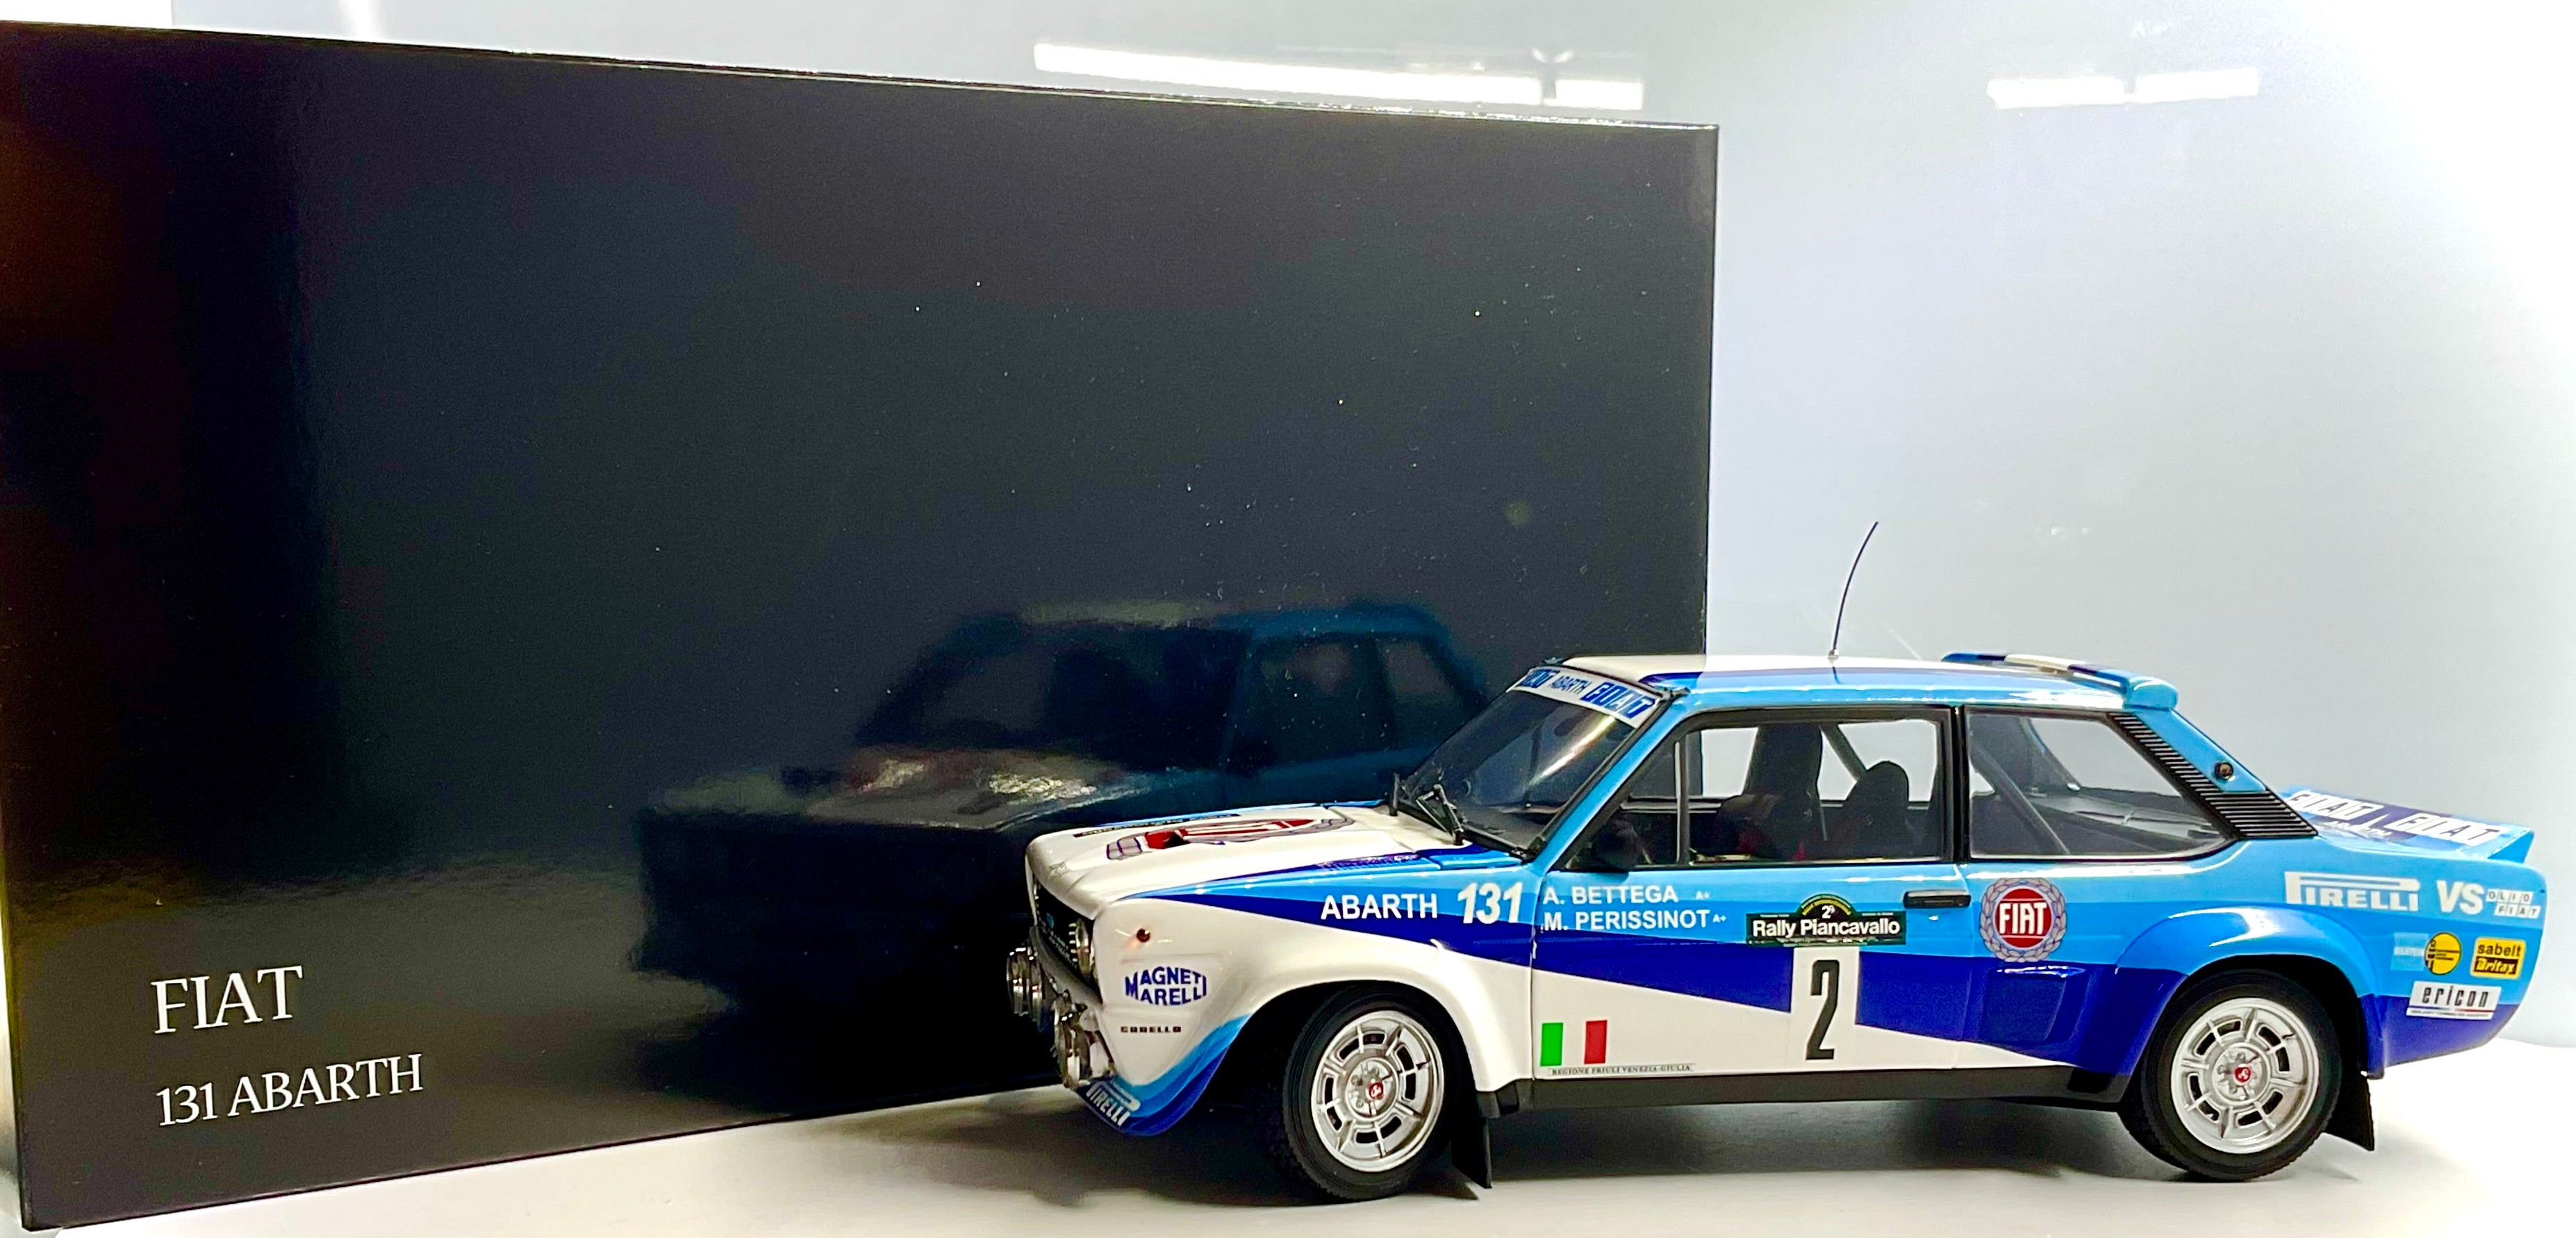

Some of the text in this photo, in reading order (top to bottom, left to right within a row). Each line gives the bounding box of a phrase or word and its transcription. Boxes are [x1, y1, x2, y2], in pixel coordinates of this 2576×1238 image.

[1580, 682, 1656, 718] FIAT
[2395, 814, 2502, 842] FIAT
[1321, 882, 1524, 924] ABARTH 131
[1543, 886, 1565, 905] A.
[1571, 885, 1678, 904] BETTEGA
[2284, 871, 2484, 915] PIRELLI VS
[2487, 889, 2532, 903] OLIO
[1544, 911, 1568, 931] M.
[1575, 909, 1710, 930] PERISSINOT
[1998, 902, 2049, 936] FIAT
[2497, 905, 2538, 917] FIAT
[1753, 918, 1901, 939] Rally Piancavallo
[2477, 943, 2522, 957] sabelt
[1125, 966, 1207, 993] MAGNETI
[1125, 980, 1207, 1006] MARELLI
[151, 965, 303, 1034] FIAT
[1806, 959, 1840, 1060] 2
[2422, 985, 2489, 1007] ericon
[1552, 1067, 1590, 1075] REGIONE
[1592, 1065, 1619, 1074] FRIULI
[156, 1053, 423, 1125] 131 ABARTH
[1086, 1078, 1141, 1126] PIRELLI
